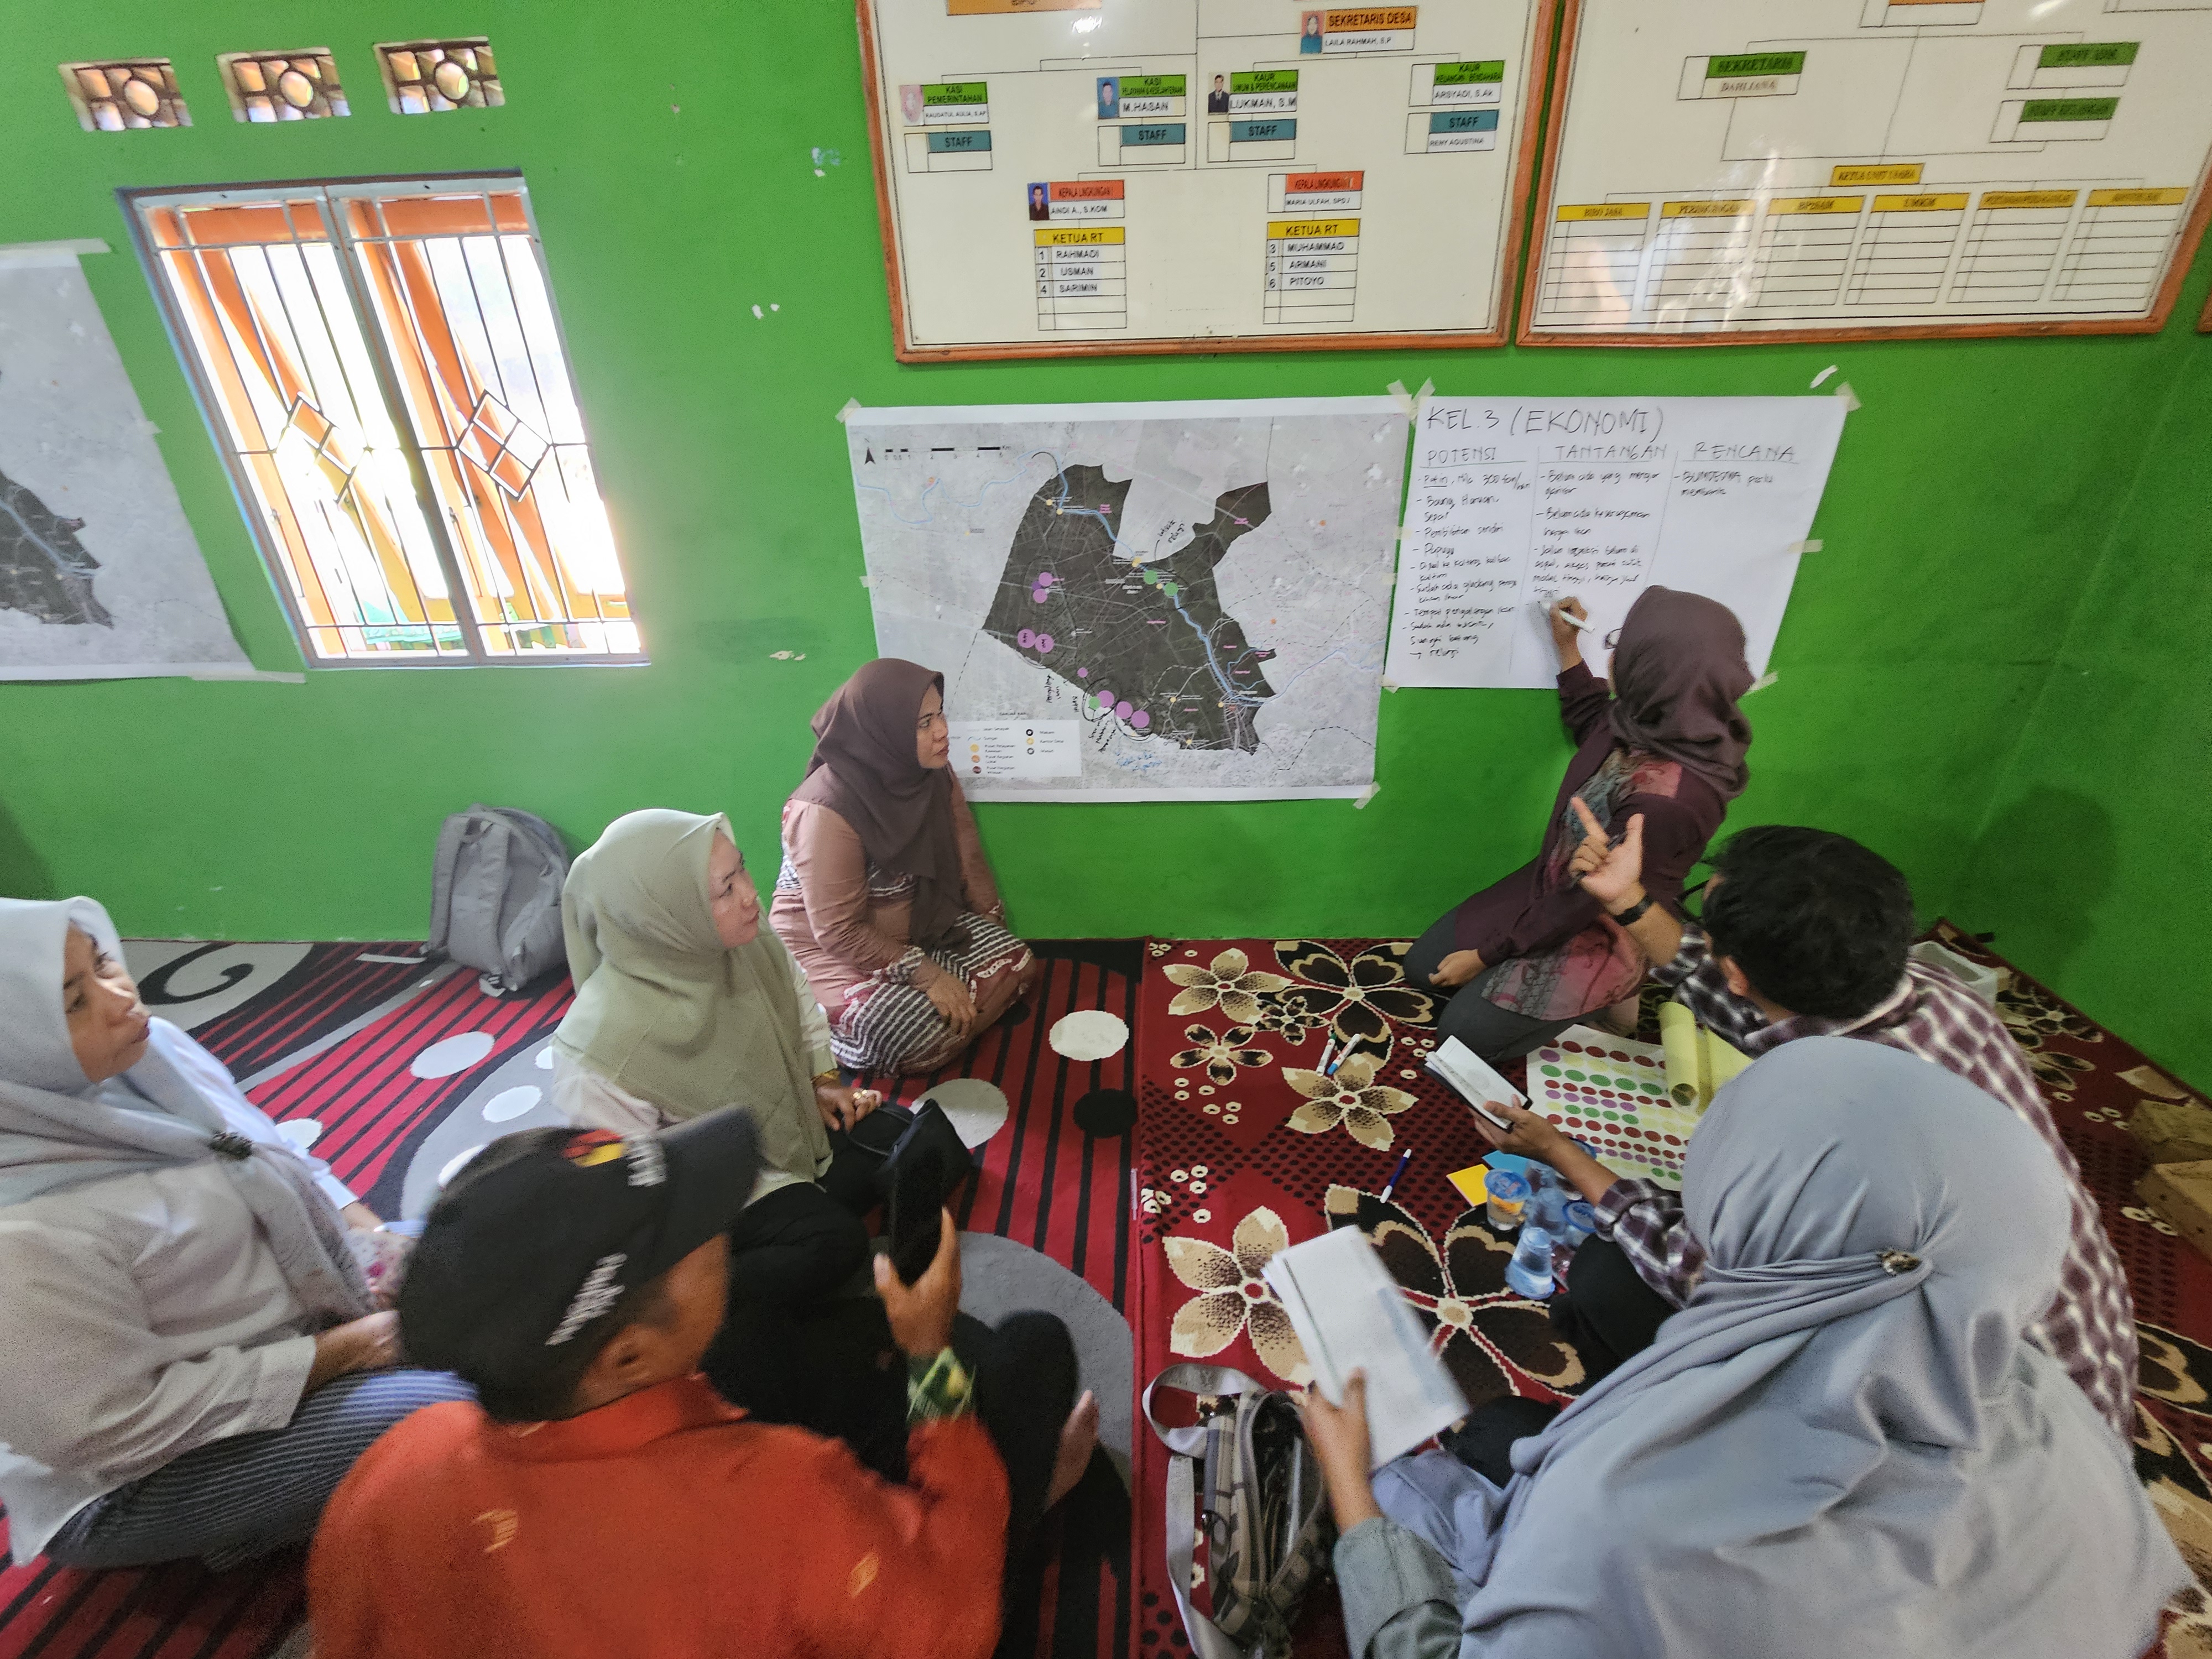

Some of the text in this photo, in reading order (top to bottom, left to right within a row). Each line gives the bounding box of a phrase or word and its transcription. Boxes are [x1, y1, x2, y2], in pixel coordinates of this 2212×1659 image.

[1329, 11, 1411, 27] SEKRETARIS DESA
[1459, 63, 1480, 72] KAUR
[1144, 77, 1161, 86] KASI
[1254, 72, 1275, 81] KAUR
[928, 94, 983, 103] PEMERINTAHAN
[1229, 98, 1276, 109] LUKMAN,
[1449, 116, 1479, 128] STAFF
[1138, 129, 1167, 140] STAFF
[1249, 125, 1277, 137] STAFF
[945, 137, 973, 148] STAFF
[1286, 224, 1338, 236] KETUA RT
[1052, 232, 1104, 244] KETUA RT
[1270, 242, 1345, 254] 3 MUHAMMAD
[1039, 249, 1099, 260] 1 RAHMADI
[1270, 262, 1276, 271] 5
[1039, 267, 1094, 278] 2 USMAN
[1269, 276, 1325, 288] 6 PITOYO
[1041, 283, 1098, 294] 4 SARIMIN
[1510, 406, 1663, 443] (EKONOMI)
[1428, 447, 1496, 466] POTENSI
[1555, 444, 1668, 460] TANTANGAN
[1694, 441, 1794, 461] RENCANA
